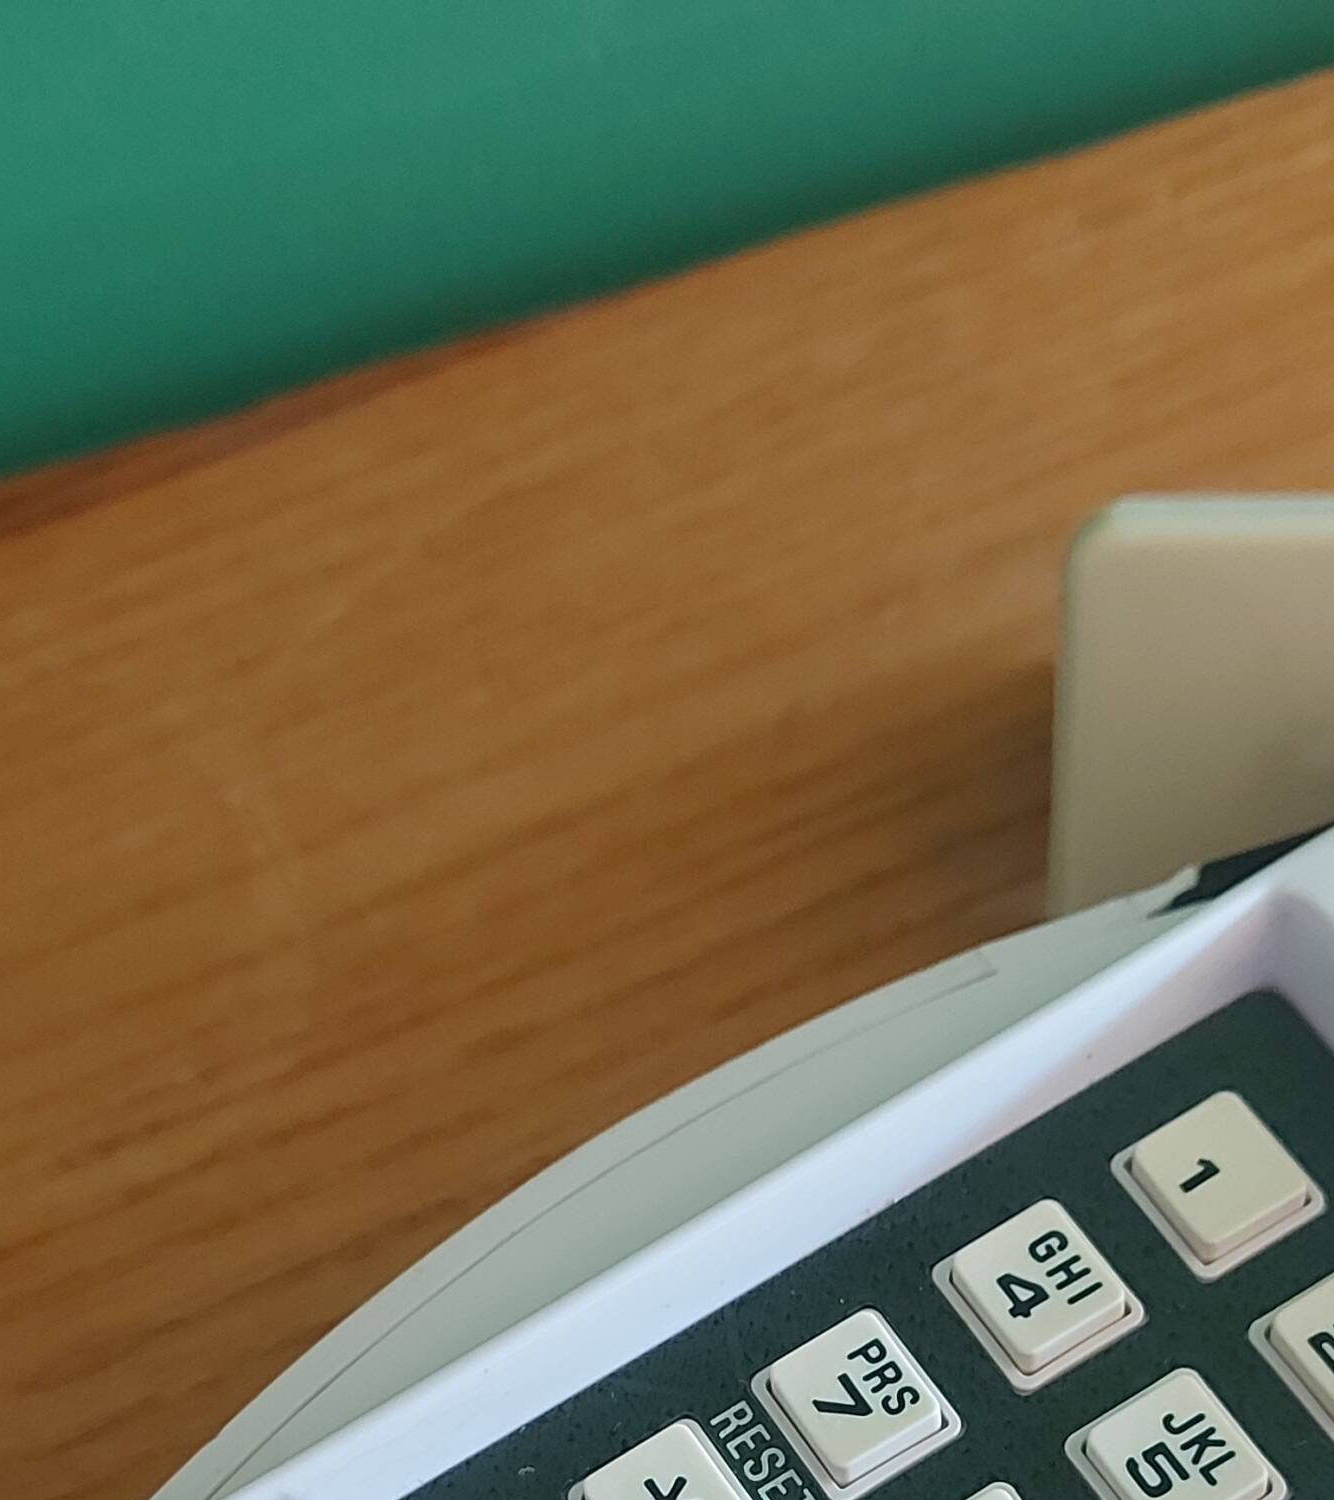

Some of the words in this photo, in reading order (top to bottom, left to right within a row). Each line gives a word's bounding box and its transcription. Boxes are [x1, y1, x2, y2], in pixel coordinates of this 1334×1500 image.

[1179, 1157, 1220, 1194] 1
[994, 1272, 1051, 1319] 4
[1027, 1229, 1104, 1306] GHI
[812, 1372, 874, 1423] 7
[846, 1338, 921, 1416] PRS
[1125, 1441, 1191, 1499] 5
[1162, 1412, 1236, 1487] JKL
